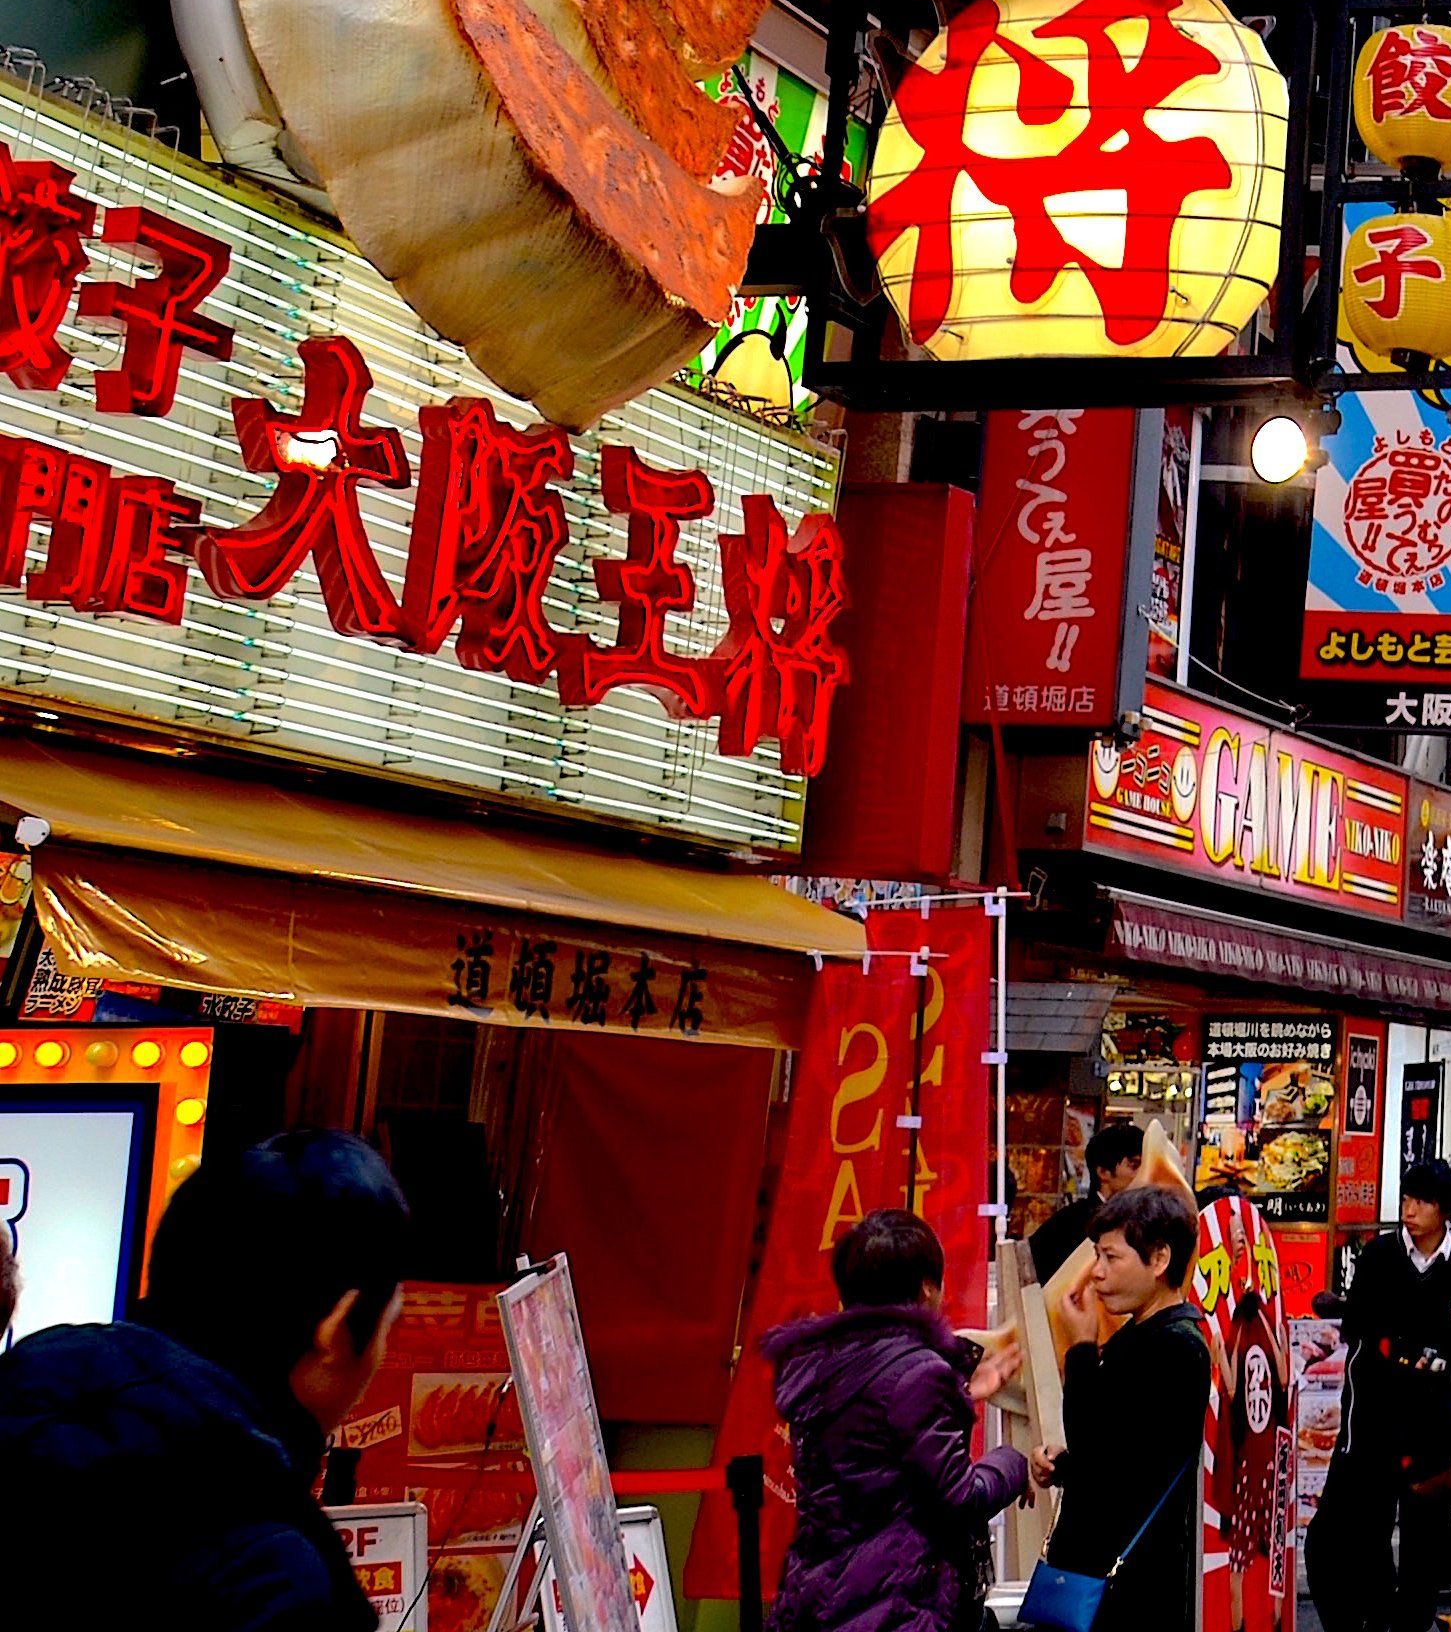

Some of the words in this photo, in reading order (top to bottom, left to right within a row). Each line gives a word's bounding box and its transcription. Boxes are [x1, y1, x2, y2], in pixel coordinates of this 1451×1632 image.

[0, 434, 204, 627] 門店
[193, 335, 854, 778] 大阪王将
[984, 686, 1095, 714] 道頓堀店
[1200, 728, 1342, 891] GAME
[1344, 815, 1399, 866] NIKO-NIKO
[449, 930, 707, 1037] 道頓堀本店
